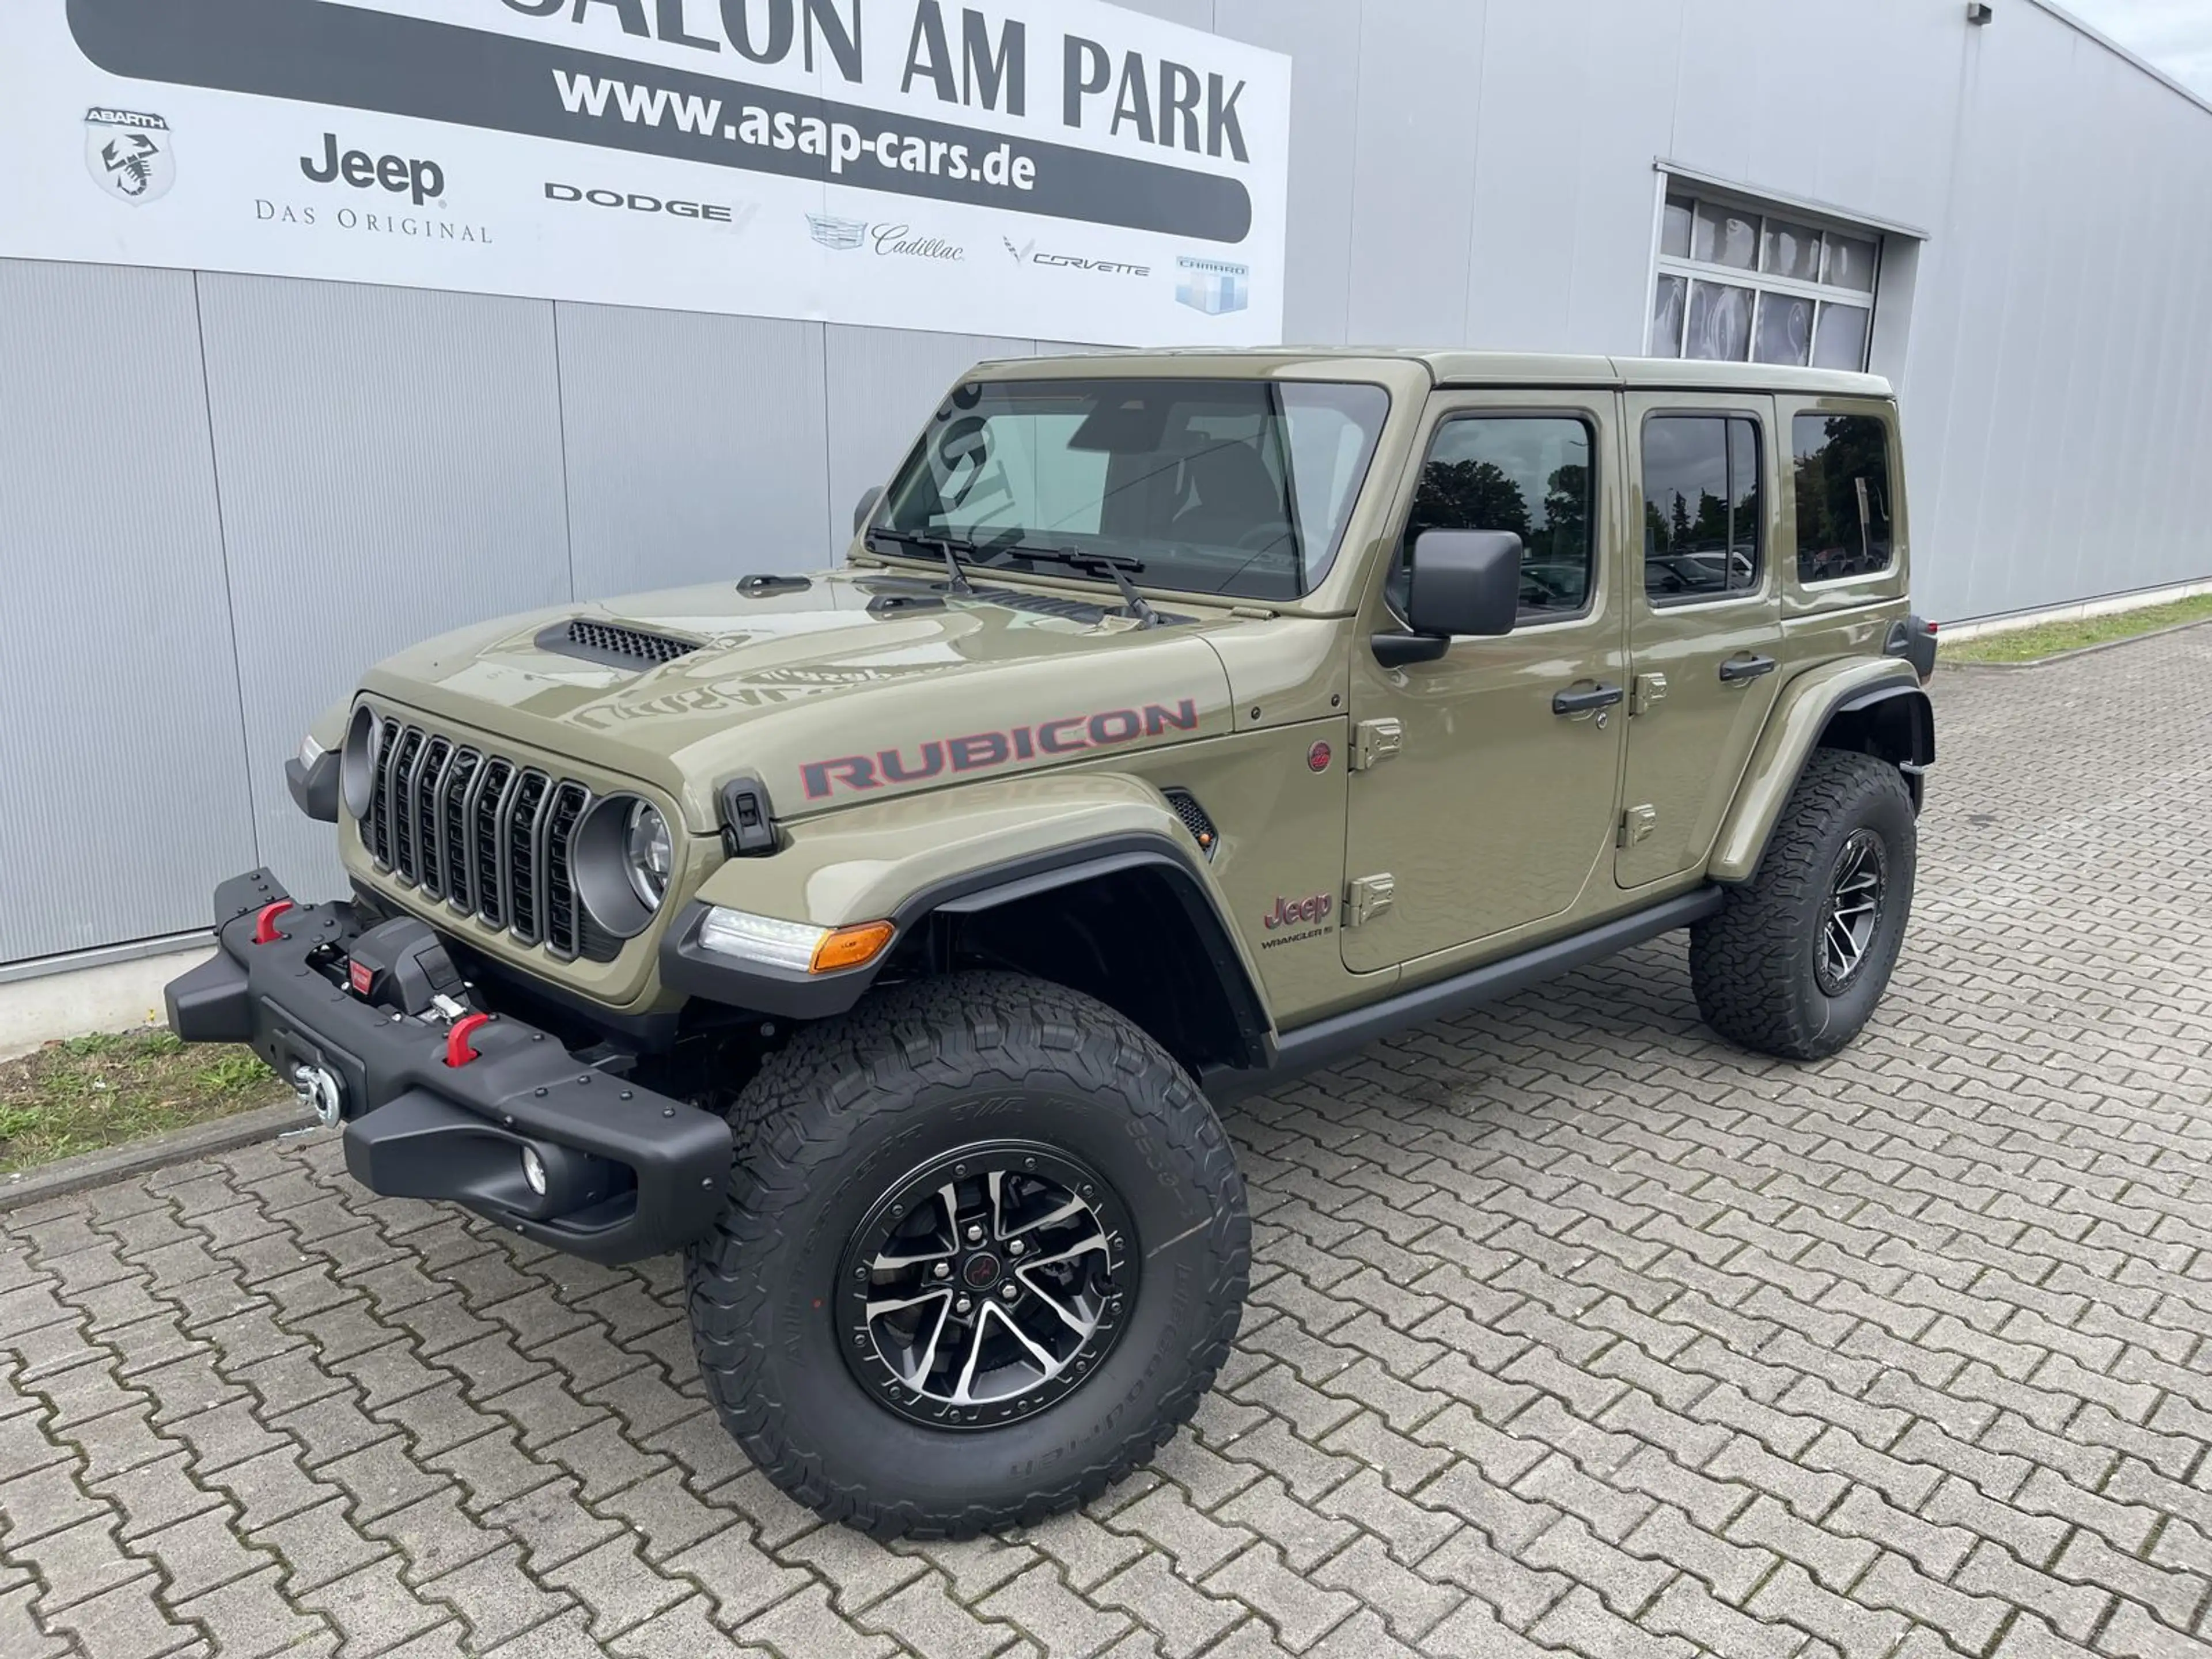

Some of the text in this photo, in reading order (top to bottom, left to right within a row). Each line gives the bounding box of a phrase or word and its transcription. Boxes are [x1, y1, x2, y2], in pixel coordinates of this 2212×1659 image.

[900, 0, 1025, 117] AM
[1062, 33, 1249, 164] PARK
[88, 110, 165, 128] ABARTH
[551, 69, 1036, 191] www.asap-cars.de
[300, 133, 445, 206] Jeep
[255, 199, 493, 244] DAS ORIGINAL
[544, 183, 732, 222] DODGE
[871, 223, 964, 261] Cadillac
[1033, 253, 1151, 276] CORVETTE
[1179, 260, 1245, 275] CAMARO
[800, 698, 1199, 800] RUBICON
[1264, 893, 1332, 929] Jeep
[1262, 929, 1322, 949] WRANGLER
